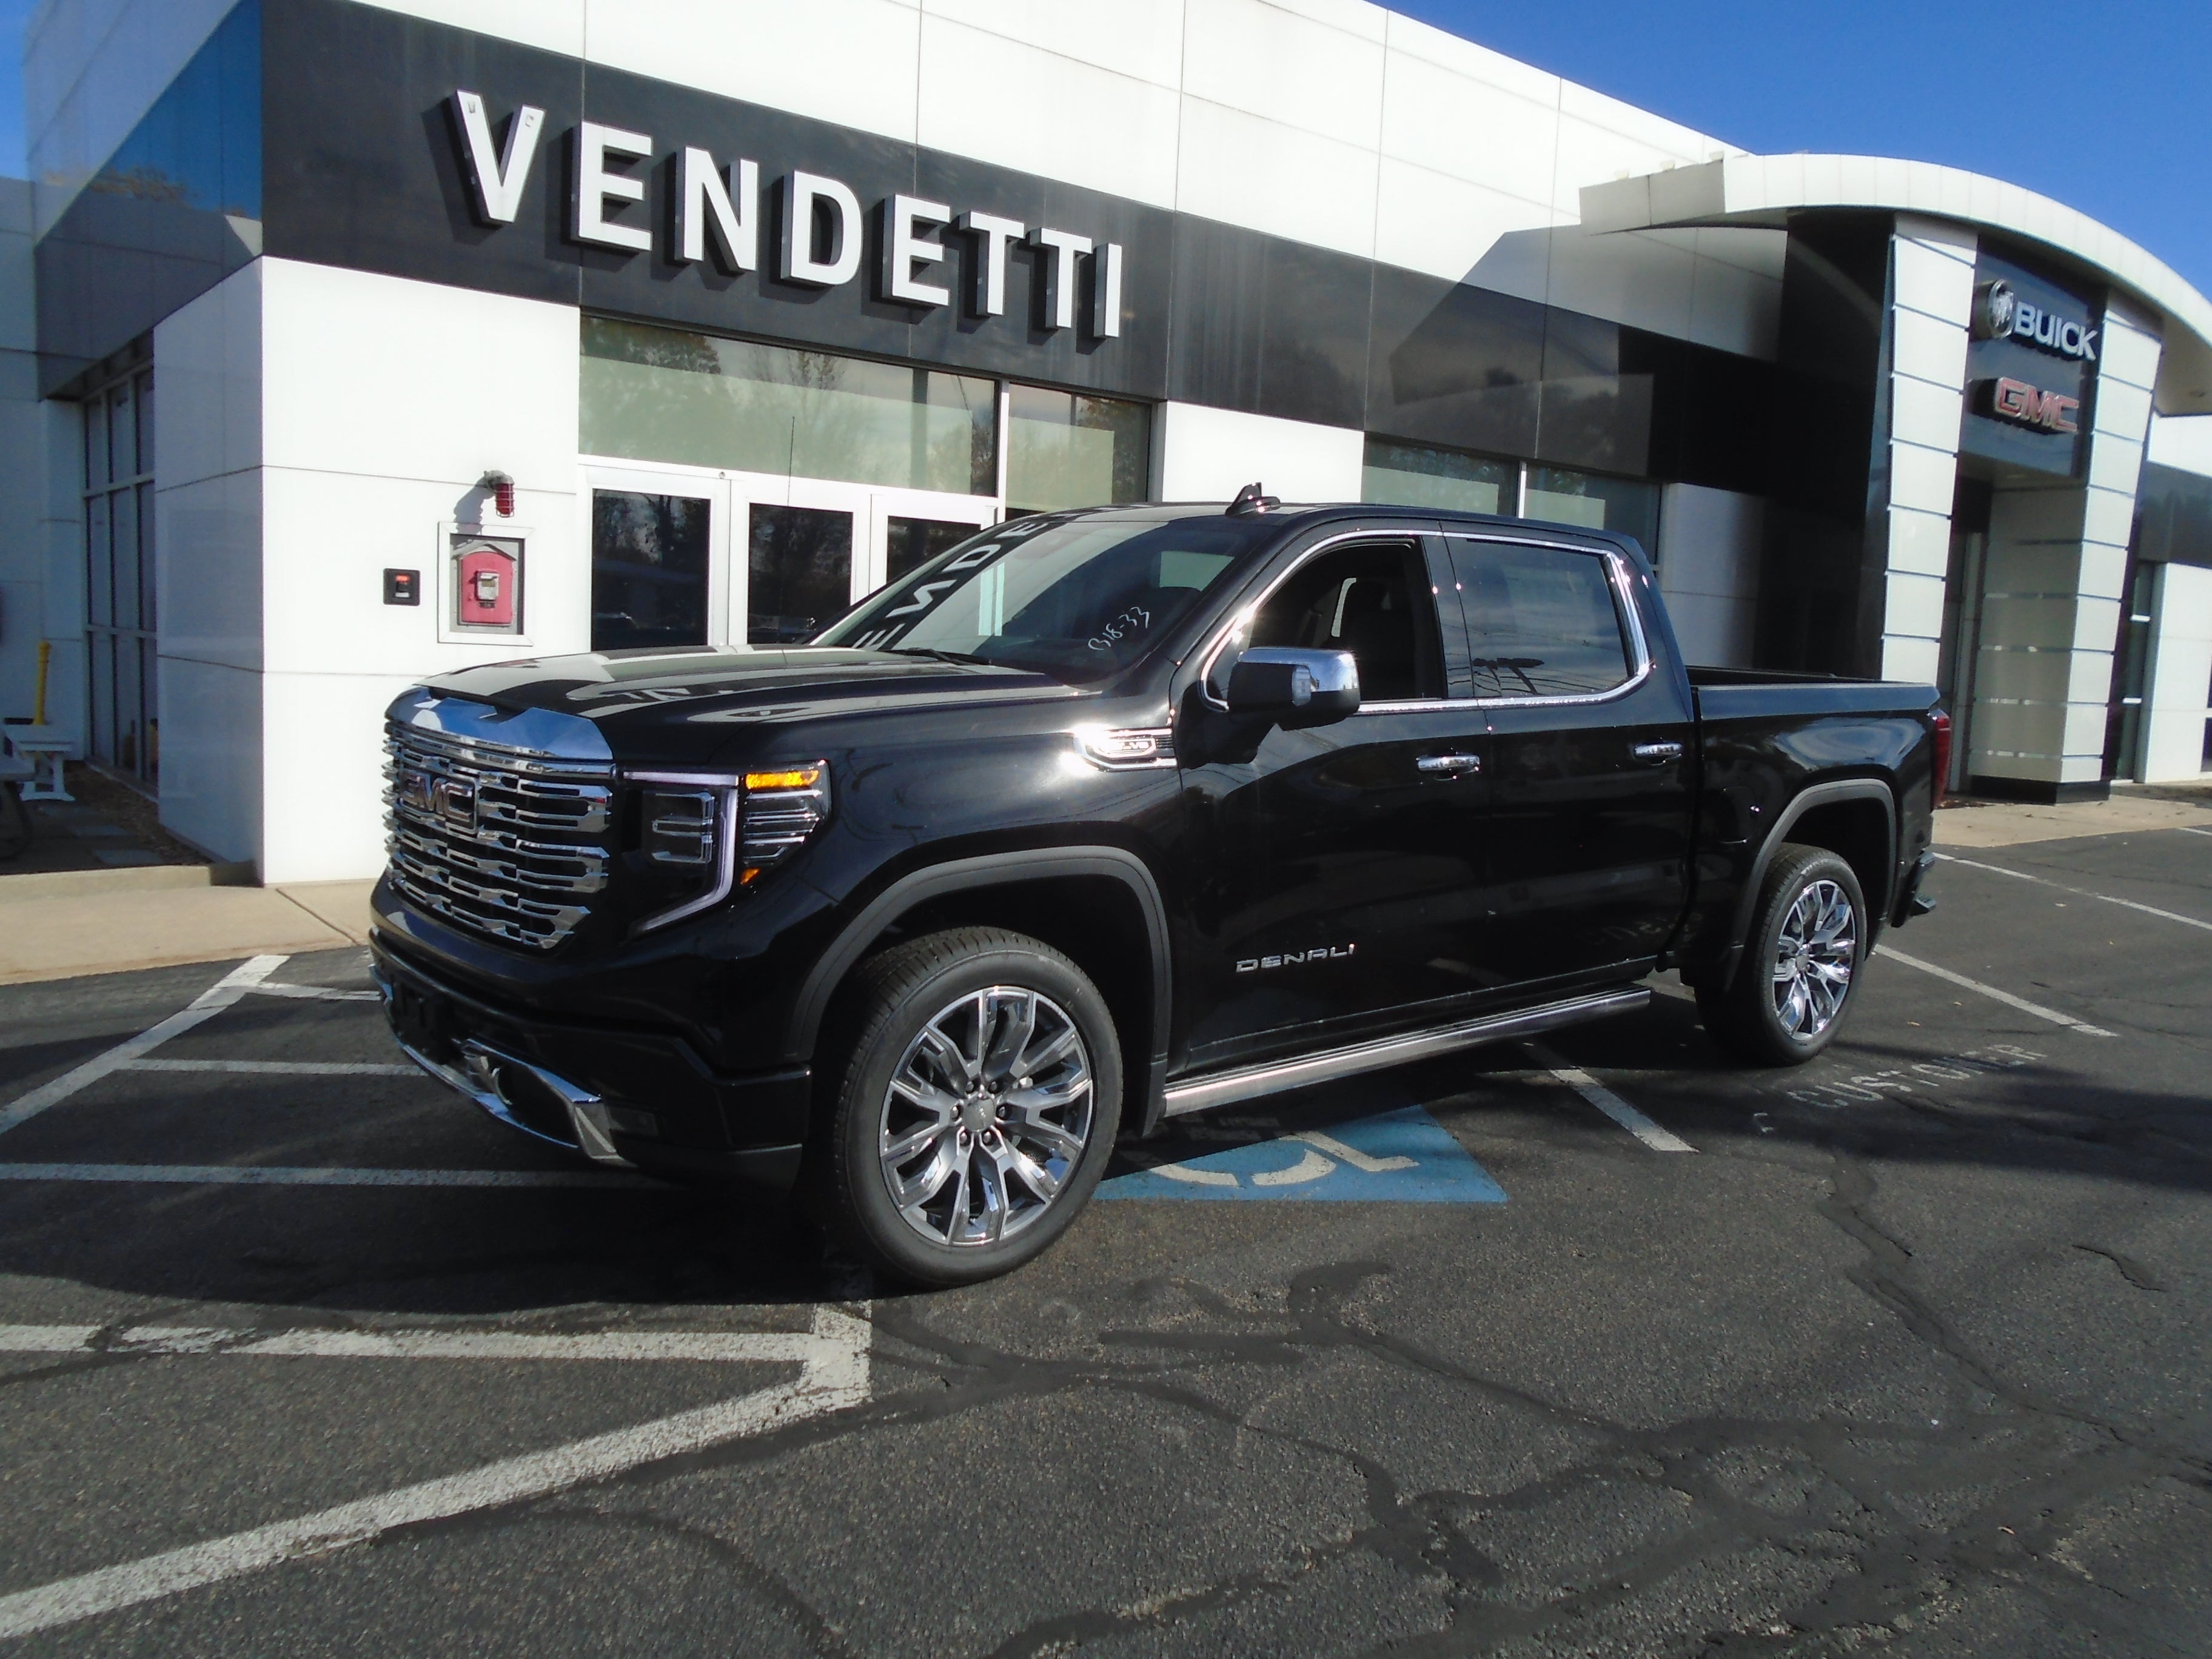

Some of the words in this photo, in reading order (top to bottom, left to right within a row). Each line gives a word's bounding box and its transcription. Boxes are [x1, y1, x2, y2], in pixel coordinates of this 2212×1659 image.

[454, 90, 1123, 338] VENDETTI
[2014, 301, 2098, 361] BUICK
[1994, 377, 2080, 432] GMC
[1236, 943, 1355, 973] DENALI
